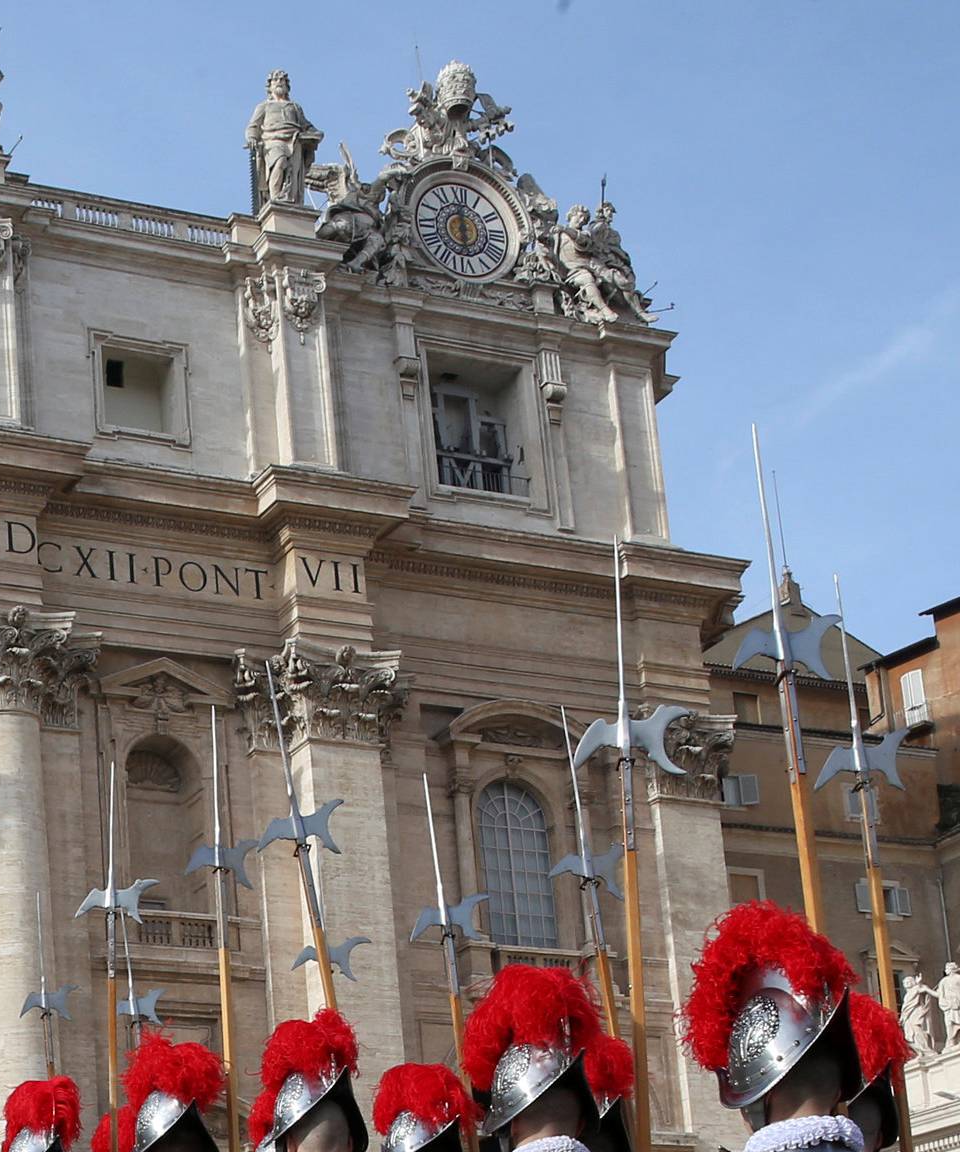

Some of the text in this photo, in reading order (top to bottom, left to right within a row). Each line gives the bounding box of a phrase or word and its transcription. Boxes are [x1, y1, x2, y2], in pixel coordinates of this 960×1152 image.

[482, 211, 499, 223] II
[488, 229, 505, 243] III
[300, 556, 363, 594] VII
